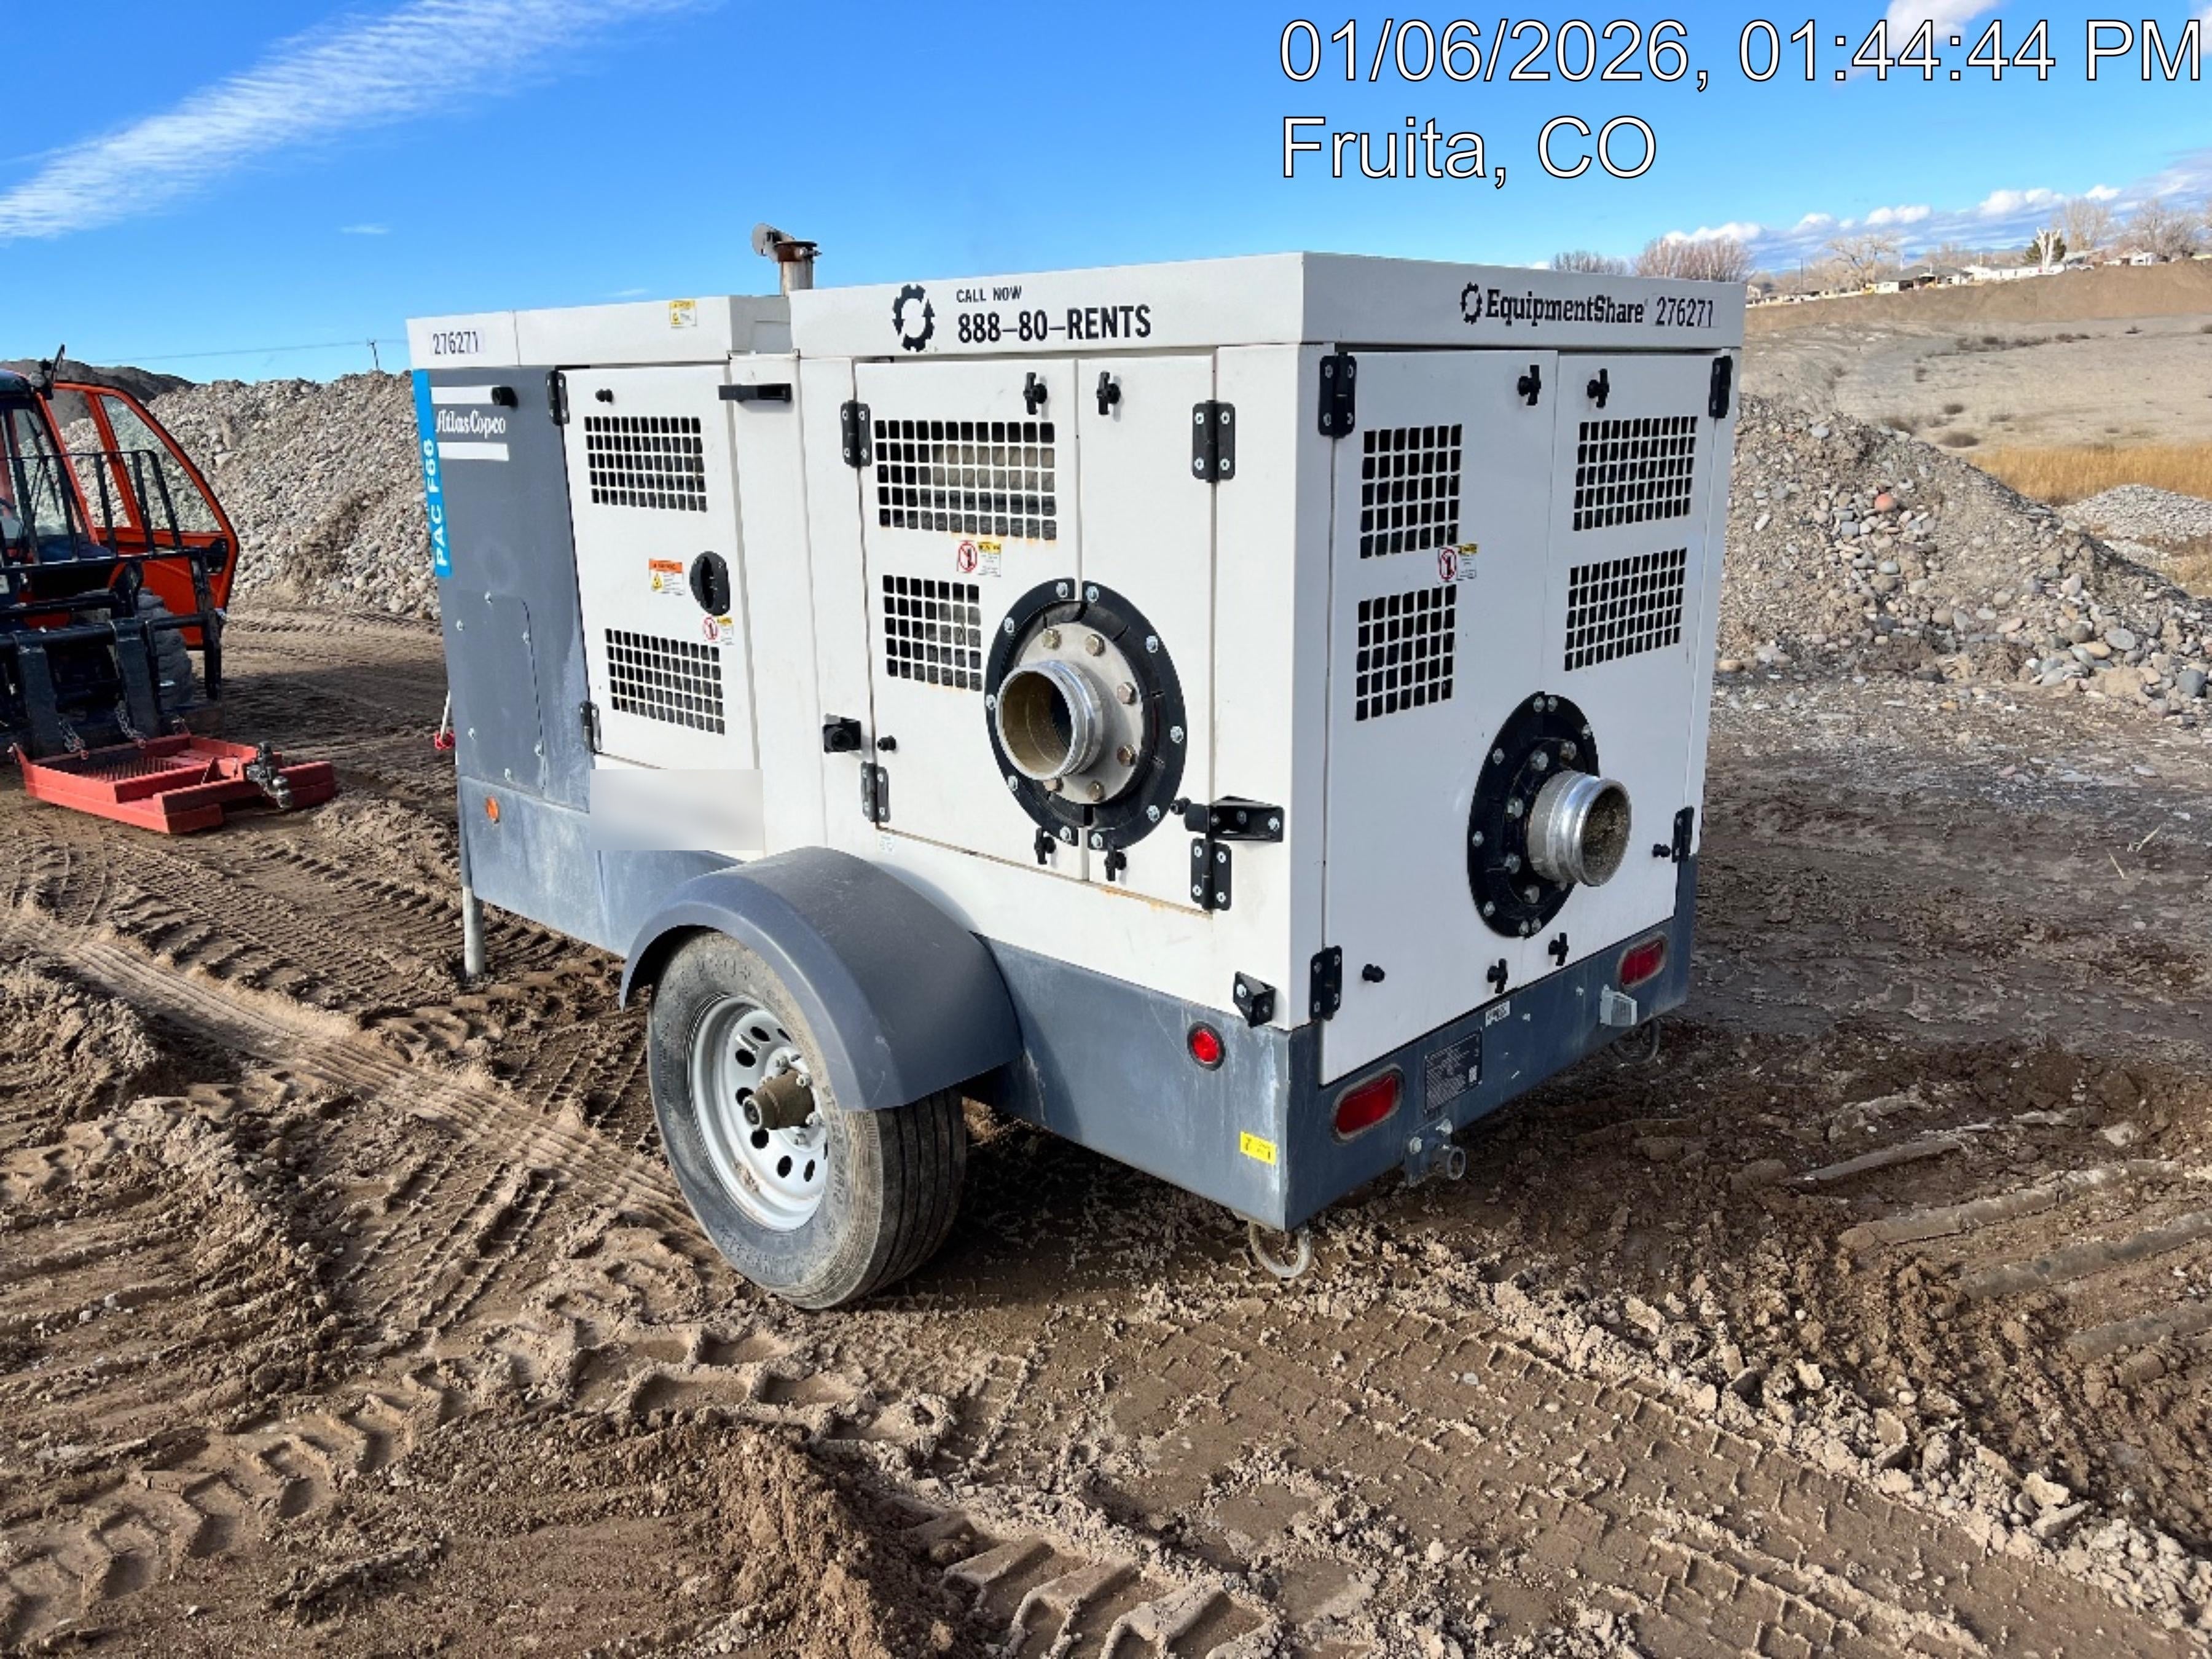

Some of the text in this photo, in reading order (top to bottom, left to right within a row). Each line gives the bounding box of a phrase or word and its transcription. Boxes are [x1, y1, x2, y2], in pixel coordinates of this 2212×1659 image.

[957, 285, 1022, 303] CALL NOW
[1485, 289, 1644, 326] EquipmentShare
[958, 304, 1151, 343] 888-80-RENTS
[1655, 296, 1714, 327] 276271
[433, 331, 478, 355] 276271
[431, 504, 448, 566] PAC
